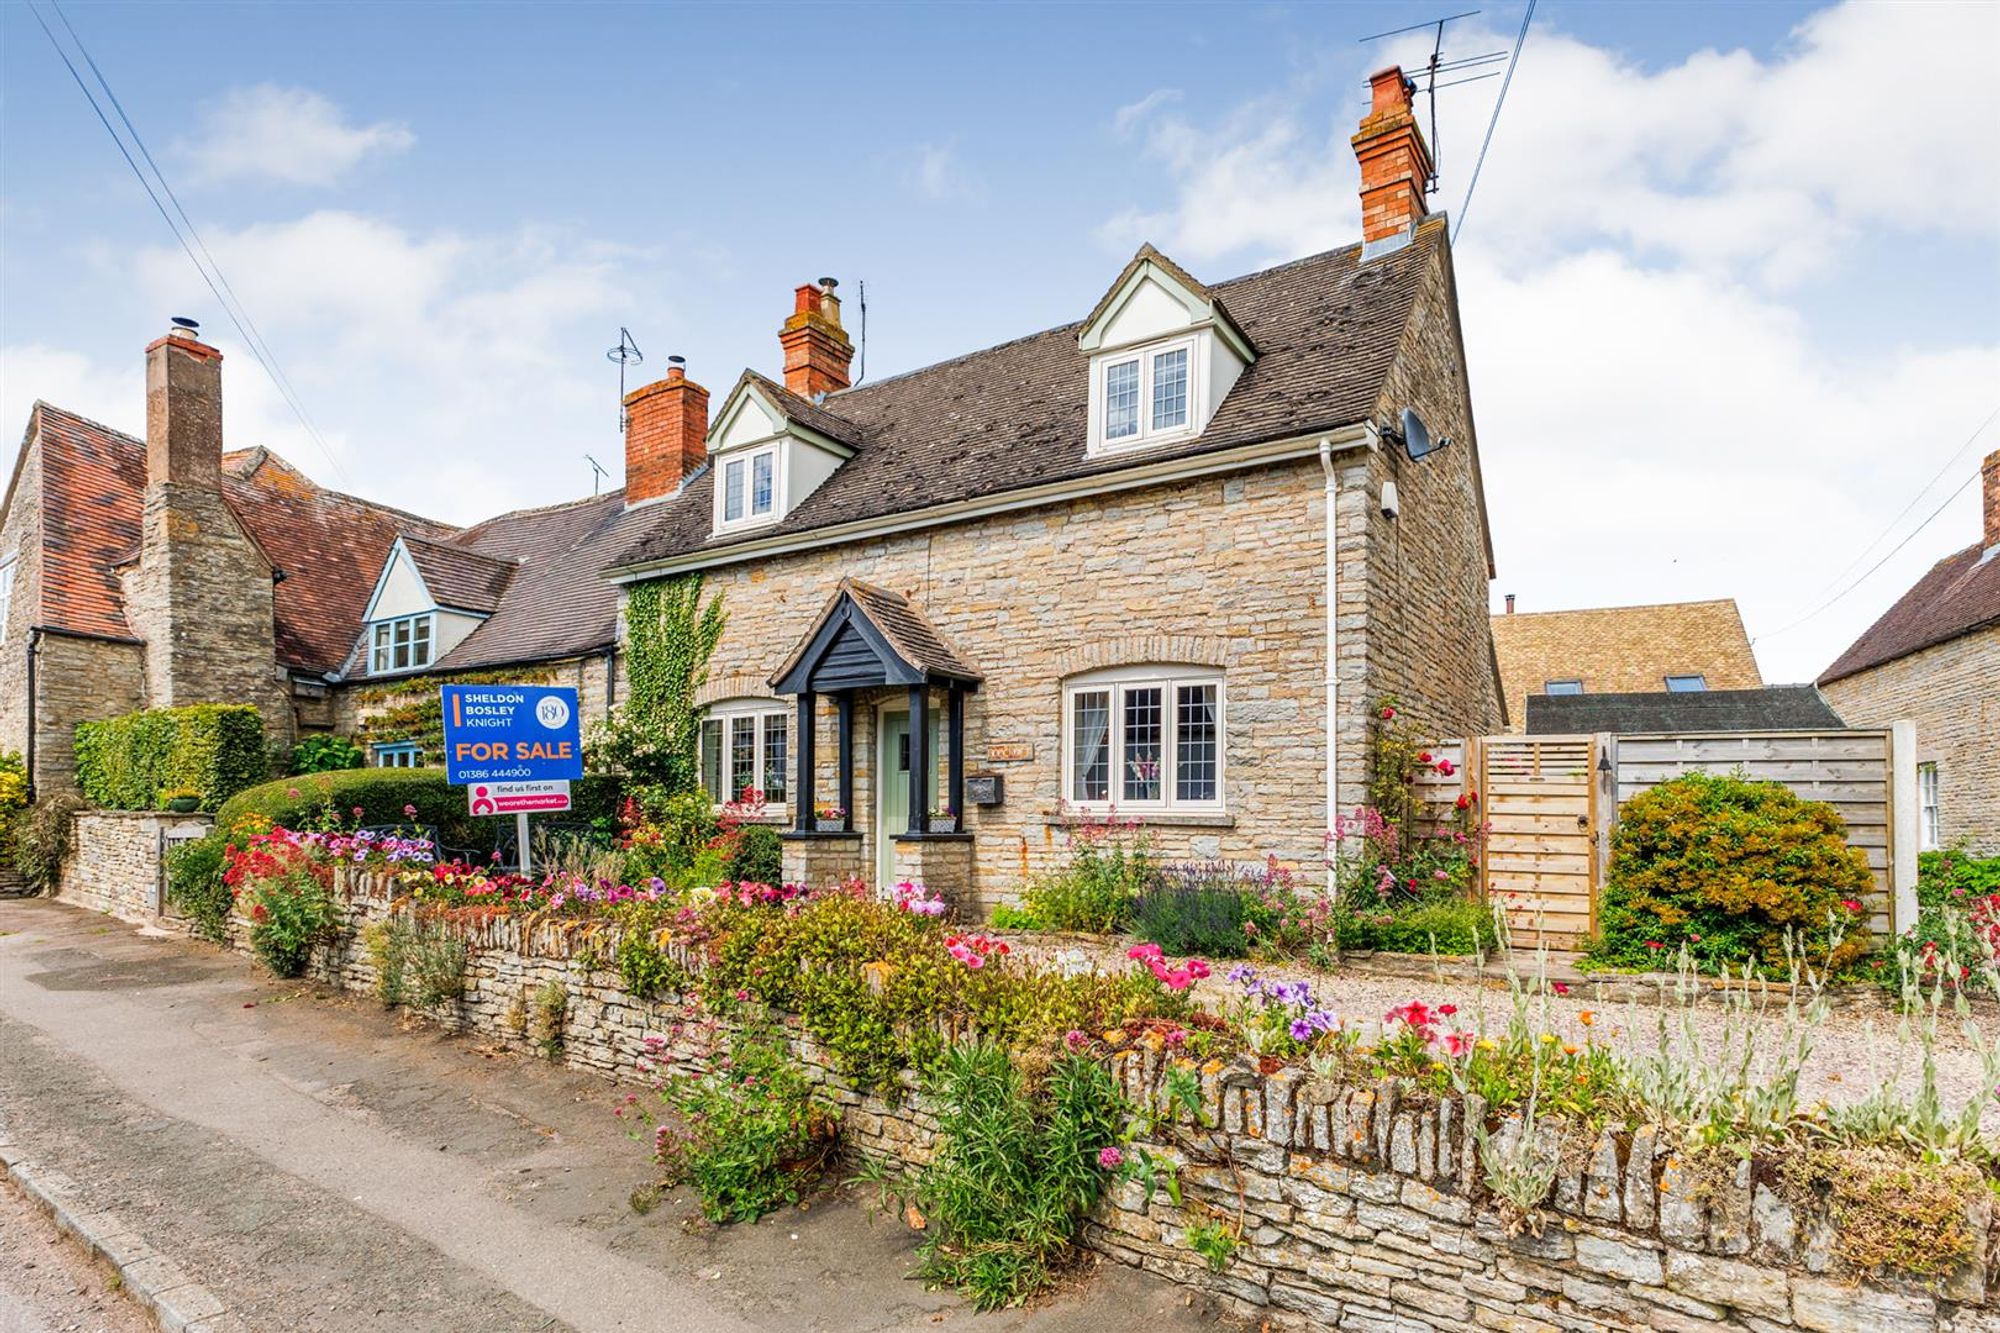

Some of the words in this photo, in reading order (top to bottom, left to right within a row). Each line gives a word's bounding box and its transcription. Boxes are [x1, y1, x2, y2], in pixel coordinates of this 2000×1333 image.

[465, 694, 524, 703] SHELDON
[465, 706, 515, 715] BOSLEY
[466, 718, 512, 727] KNIGHT
[456, 743, 509, 762] FOR
[515, 741, 573, 760] SALE
[458, 769, 489, 779] 01386
[491, 768, 532, 778] 444900
[497, 785, 513, 793] find
[526, 784, 541, 792] first
